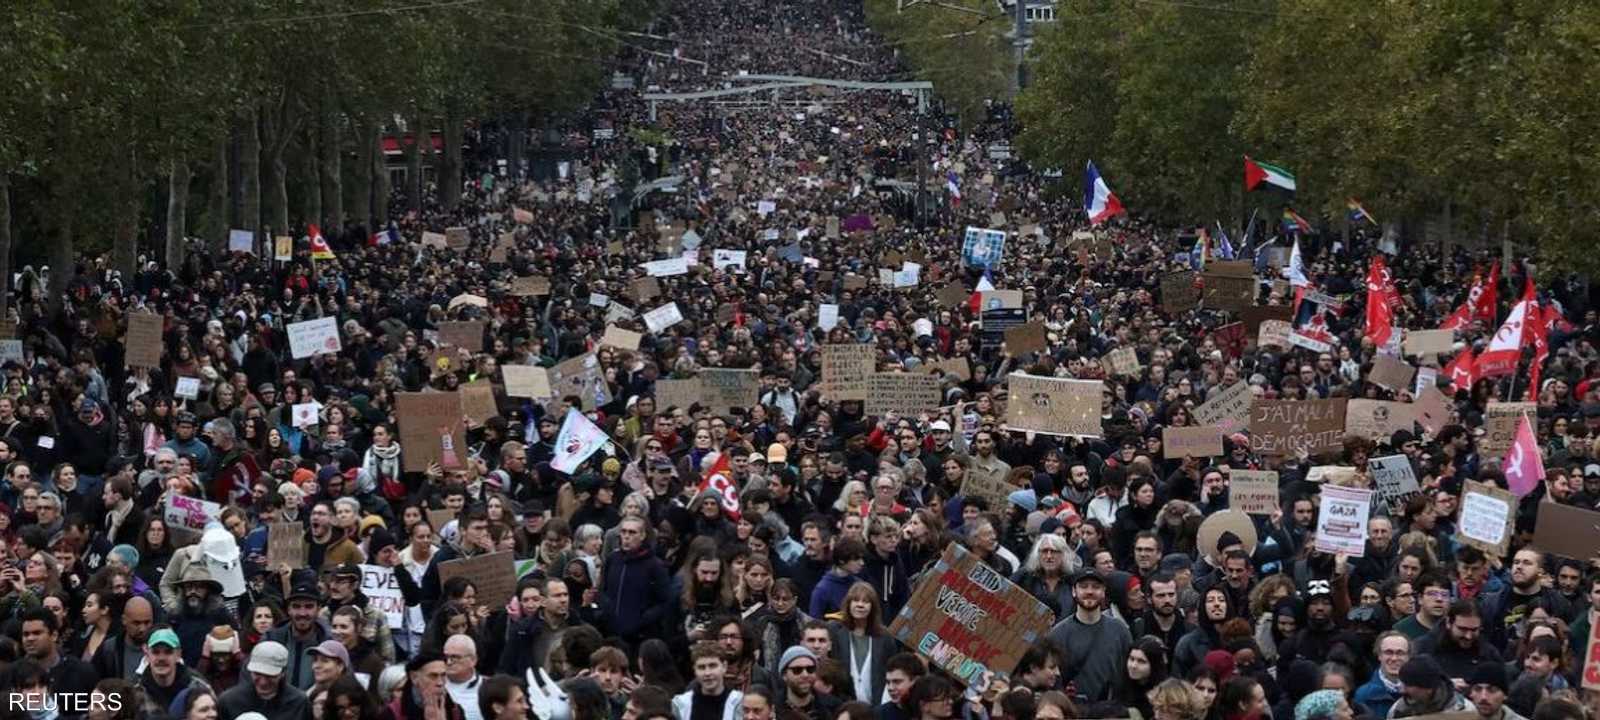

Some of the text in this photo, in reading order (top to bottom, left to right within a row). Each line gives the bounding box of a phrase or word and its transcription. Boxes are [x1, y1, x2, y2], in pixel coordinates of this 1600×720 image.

[1257, 405, 1294, 423] J'AI
[1295, 405, 1321, 421] MAL
[1370, 461, 1385, 471] LA
[1329, 505, 1357, 517] GAZA
